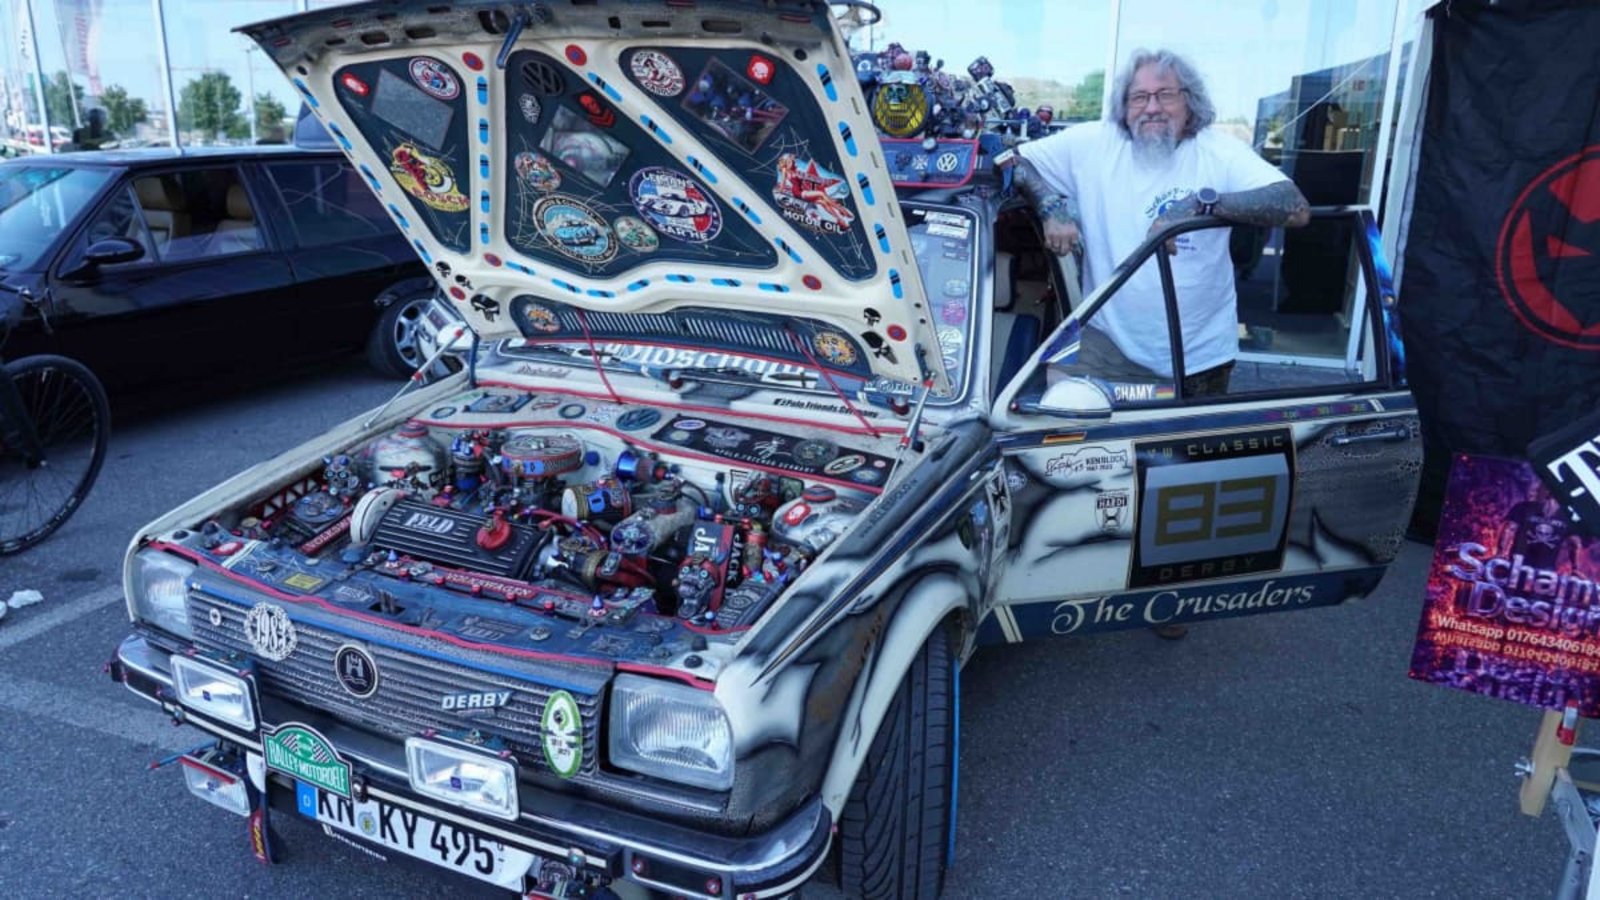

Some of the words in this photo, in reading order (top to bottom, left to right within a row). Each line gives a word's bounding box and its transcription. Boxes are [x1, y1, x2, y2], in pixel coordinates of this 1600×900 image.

[824, 221, 845, 235] OIL
[1187, 435, 1284, 456] CLASSIC
[1154, 475, 1279, 546] 83
[1160, 557, 1257, 581] DERBY
[1051, 596, 1134, 635] The
[1143, 581, 1316, 624] Crusaders
[1437, 615, 1504, 640] Whatsapp
[441, 692, 512, 709] DERBY
[379, 802, 418, 849] KY
[431, 821, 495, 876] 495
